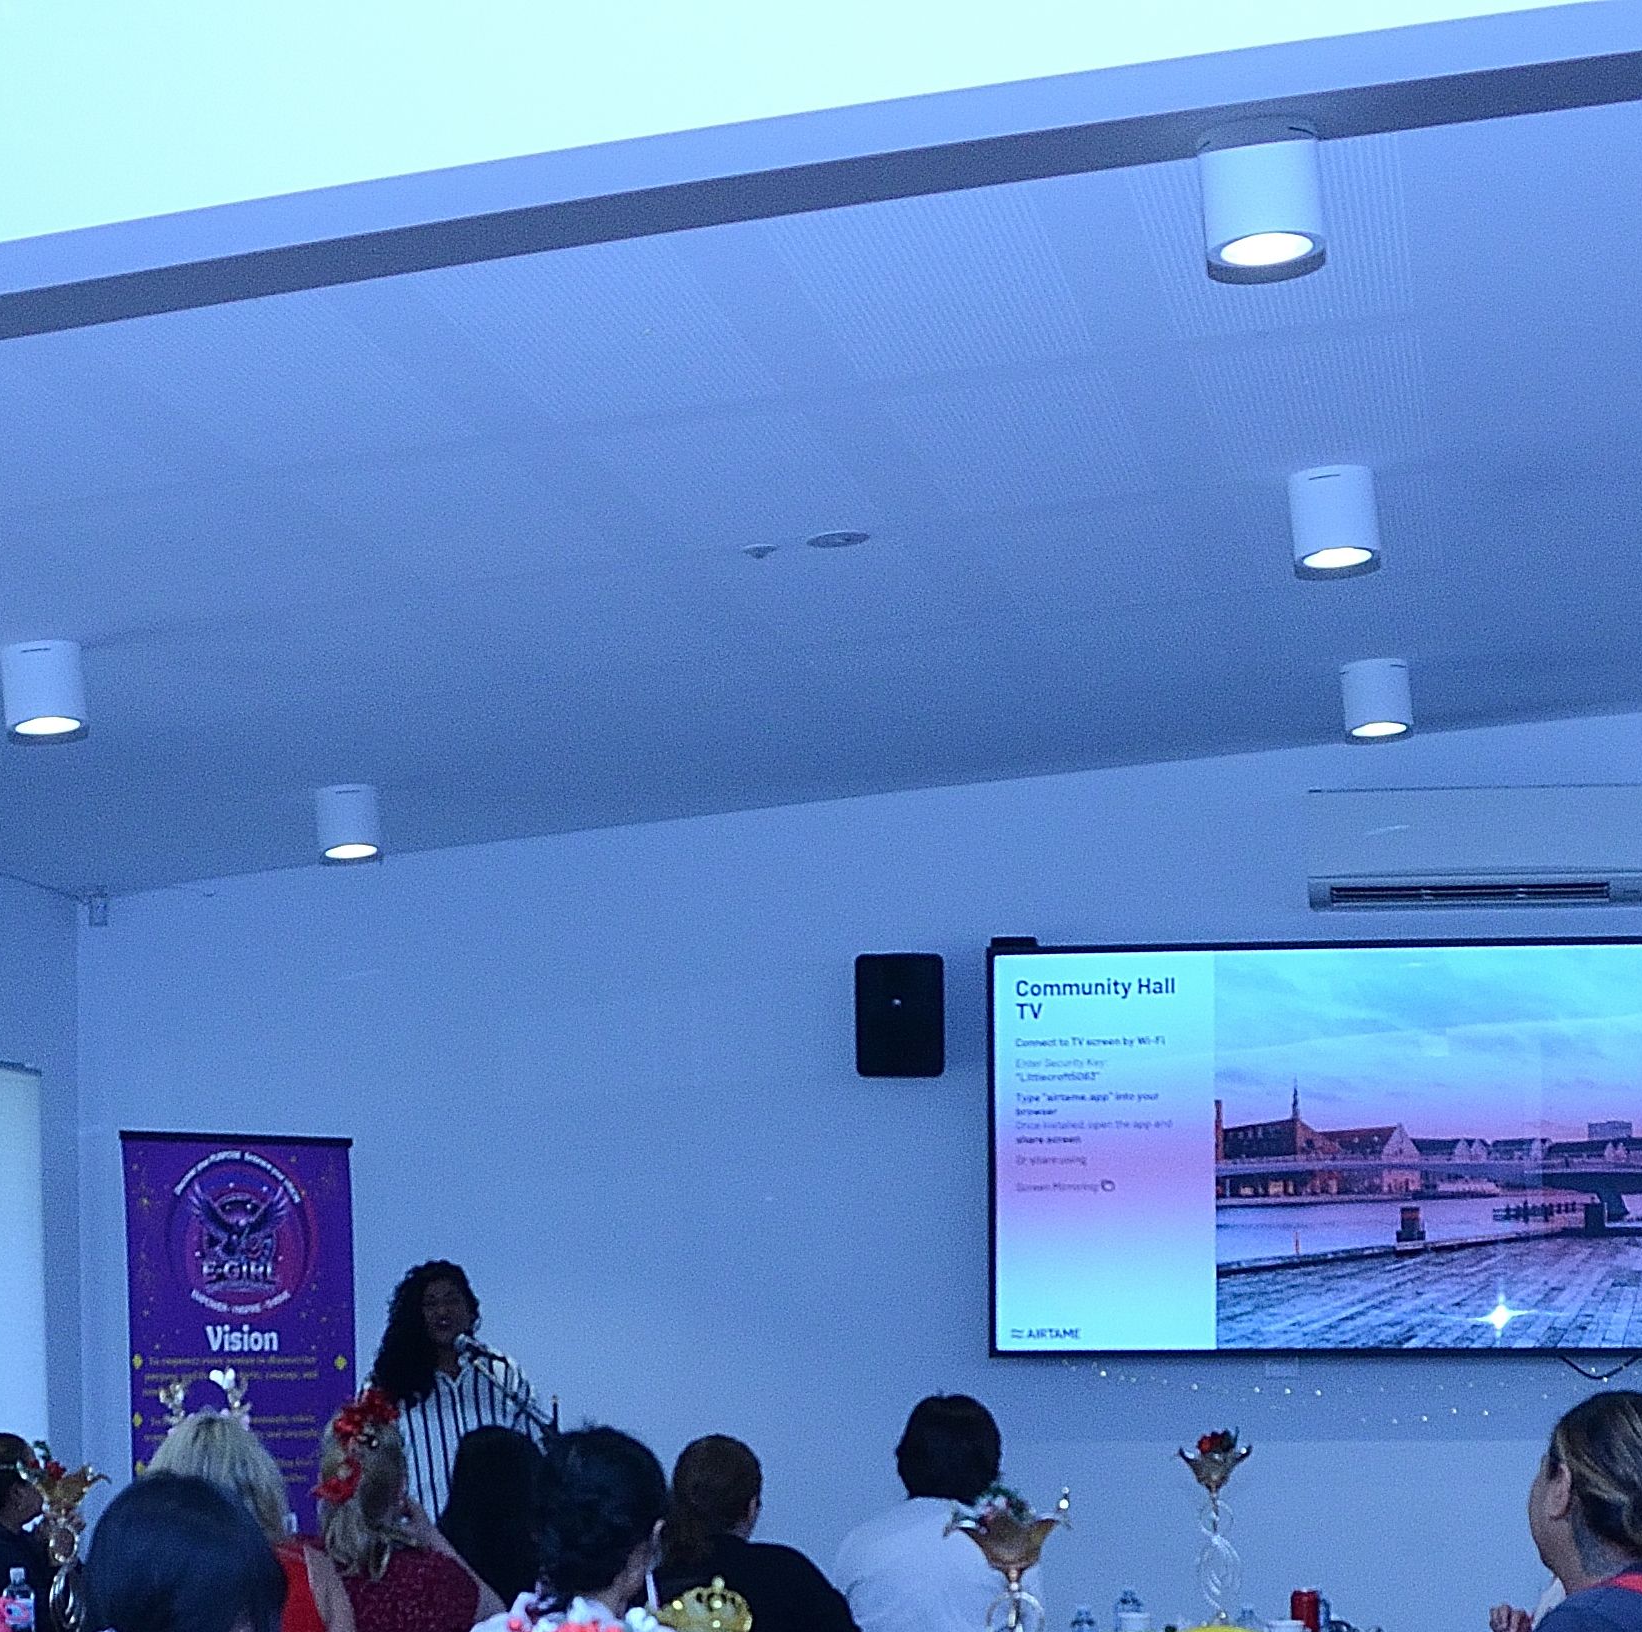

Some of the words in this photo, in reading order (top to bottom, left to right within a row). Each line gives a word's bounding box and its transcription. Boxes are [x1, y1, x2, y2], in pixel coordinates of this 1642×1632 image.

[1015, 977, 1132, 999] Community
[1137, 977, 1176, 994] Hall
[1015, 1003, 1043, 1020] TV
[1015, 1037, 1056, 1047] Connect
[1059, 1037, 1070, 1047] to
[1071, 1036, 1085, 1046] TV
[1122, 1036, 1135, 1047] by
[205, 1324, 279, 1352] Vision
